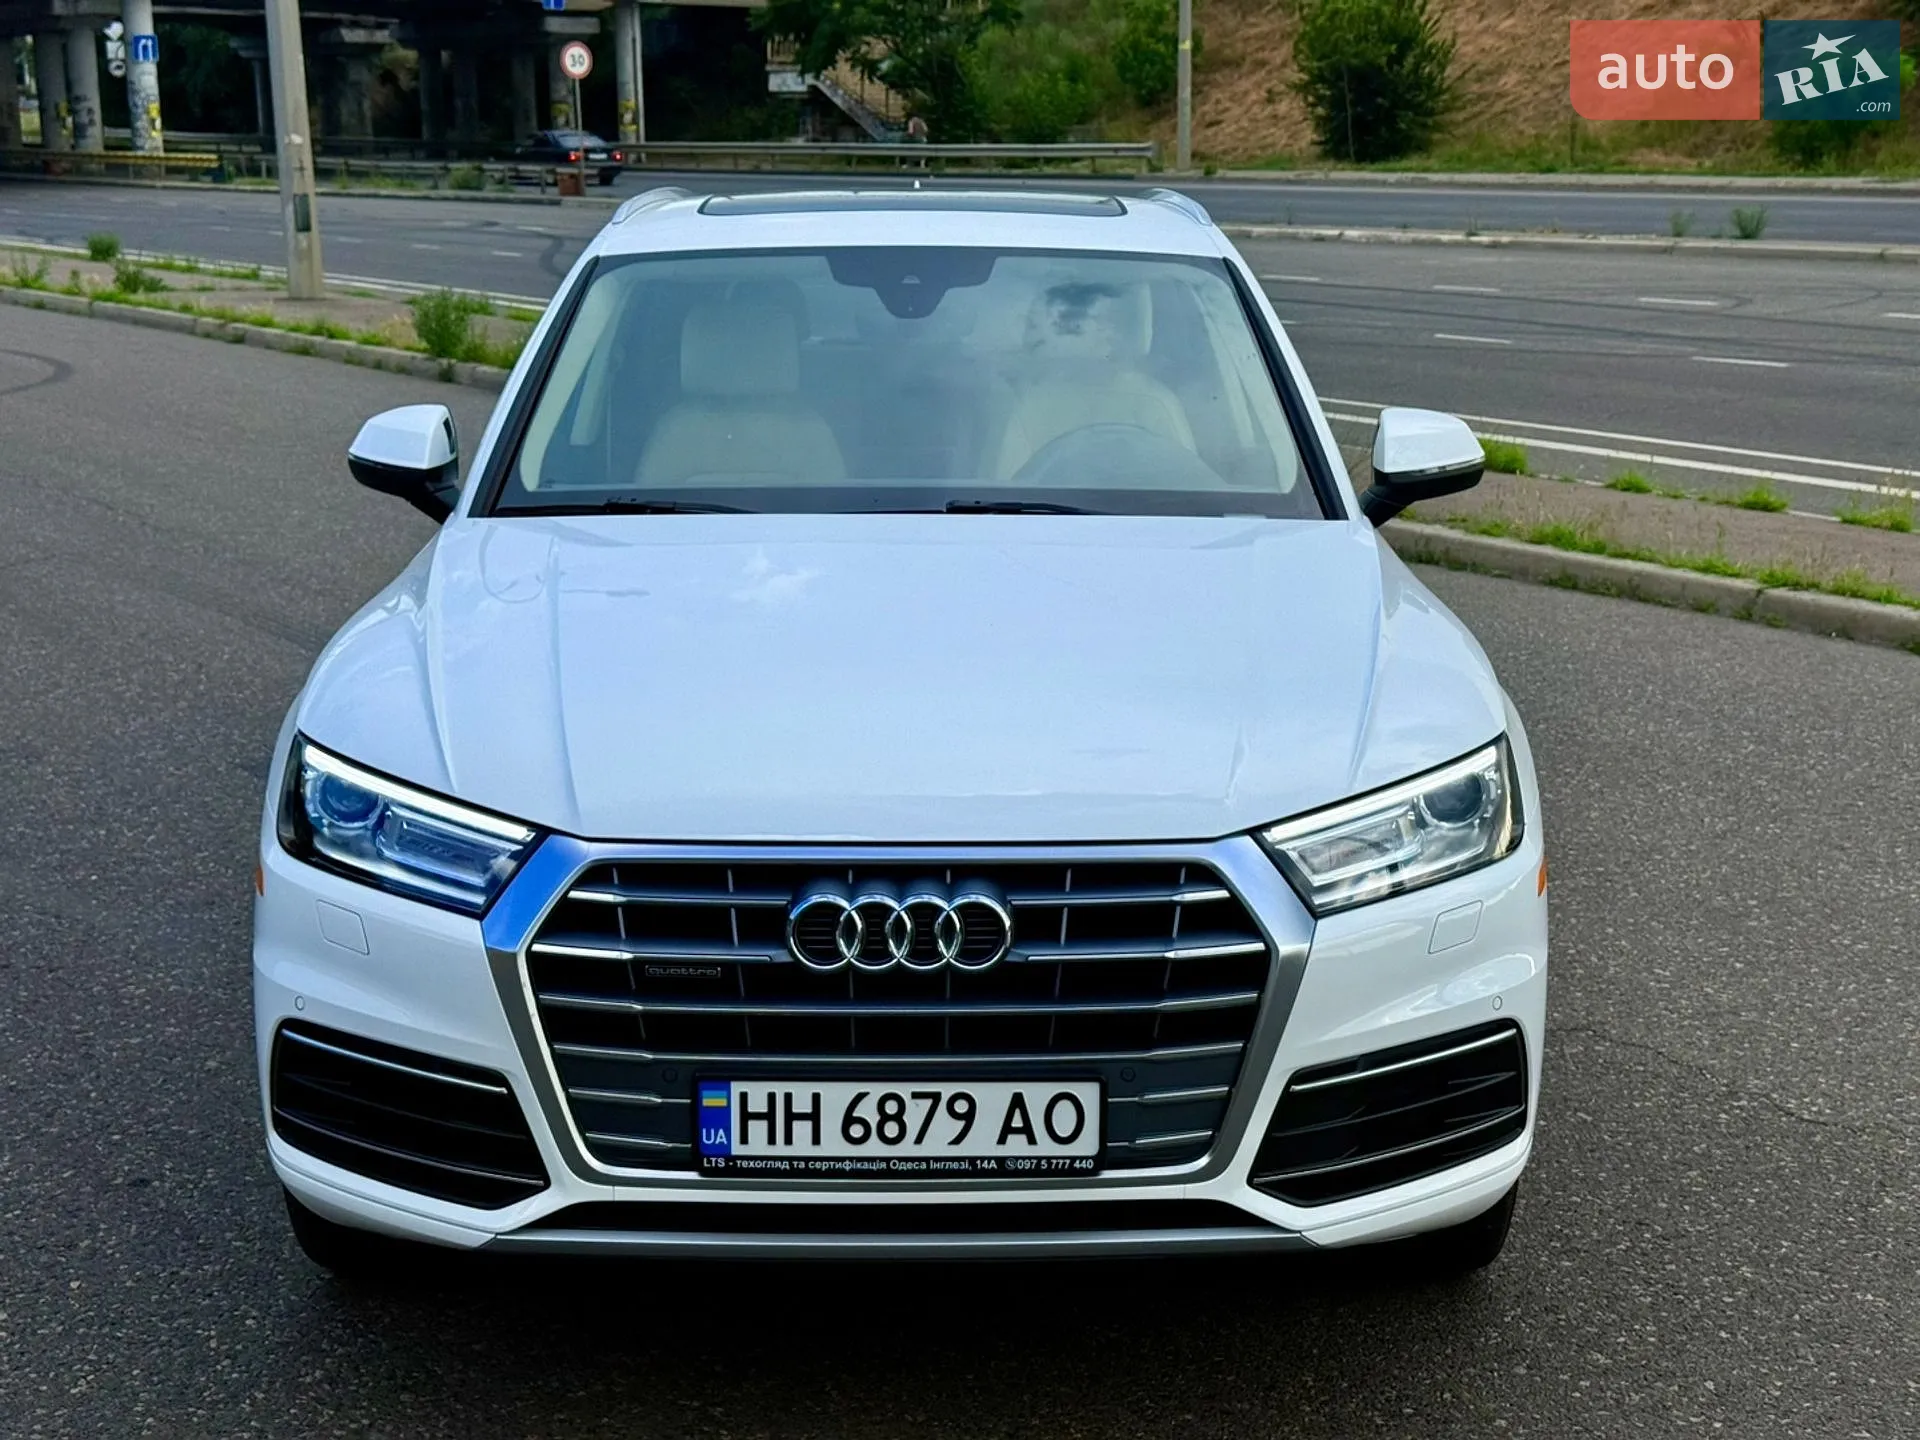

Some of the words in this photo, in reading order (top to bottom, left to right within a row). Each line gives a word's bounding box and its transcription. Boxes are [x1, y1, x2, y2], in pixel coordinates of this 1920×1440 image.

[647, 967, 717, 977] quattro
[738, 1091, 822, 1146] HH
[840, 1091, 978, 1146] 6879
[996, 1091, 1086, 1146] AO
[702, 1128, 728, 1145] UA
[703, 1157, 726, 1168] LTS
[735, 1159, 790, 1170] техогляд
[792, 1160, 805, 1169] та
[808, 1158, 887, 1172] сертифікація
[889, 1158, 927, 1171] Одеса
[929, 1159, 972, 1171] Інглезі,
[1017, 1158, 1036, 1170] 097
[1039, 1159, 1048, 1170] 5
[1050, 1159, 1070, 1170] 777
[1073, 1159, 1094, 1170] 440
